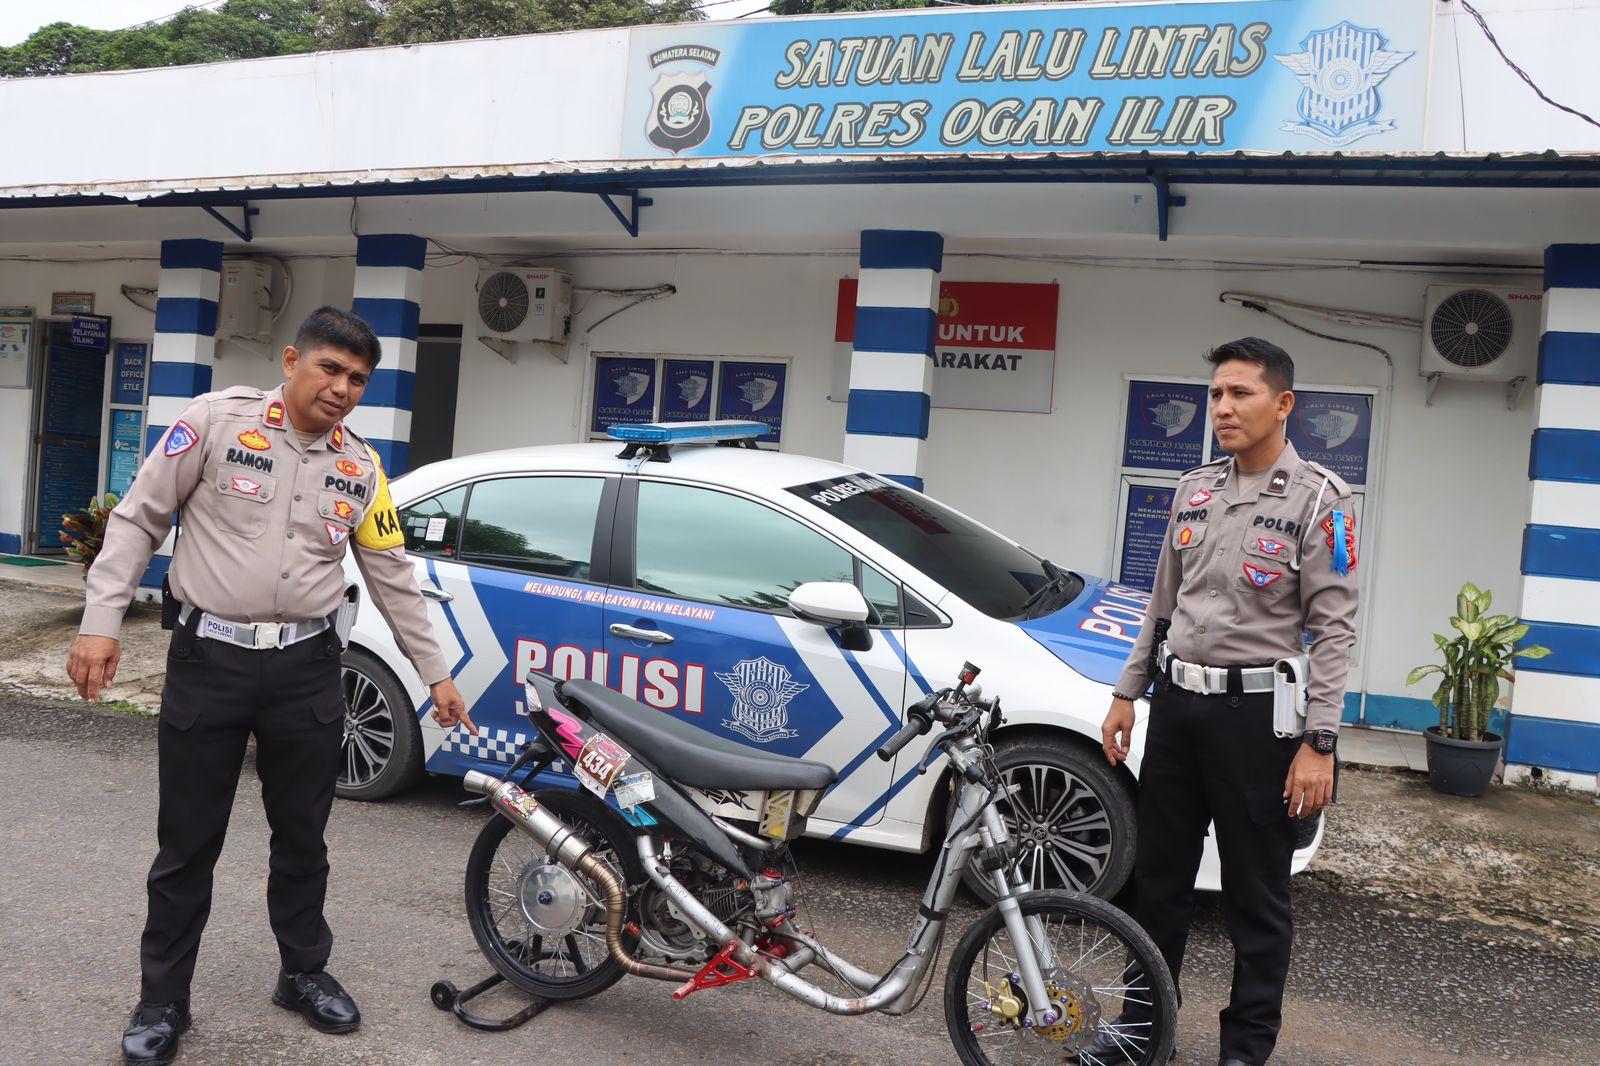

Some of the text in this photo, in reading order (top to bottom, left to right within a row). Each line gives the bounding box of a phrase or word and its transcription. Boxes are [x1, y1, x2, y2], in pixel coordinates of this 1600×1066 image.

[653, 48, 717, 64] SUMATERA SELATAN
[775, 22, 1272, 89] SATUAN LALU LINTAS
[727, 96, 1237, 150] POLRES OGAN ILIR
[1508, 293, 1543, 301] SHARP
[80, 321, 100, 330] RUANG
[938, 323, 1024, 343] UNTUK
[73, 336, 94, 345] TILANG
[123, 358, 142, 366] BACK
[120, 370, 145, 378] OFFICE
[123, 383, 140, 391] ETLE
[1167, 393, 1194, 401] LINTAS
[1327, 404, 1356, 412] LINTAS
[226, 447, 273, 473] RAMON
[325, 475, 367, 499] POLRI
[1176, 508, 1208, 523] BOWO
[1253, 514, 1300, 536] POLRI
[523, 581, 715, 621] MELINDUNGI, MENGAYOMI DAN MELAYANI
[207, 620, 233, 635] POLISI
[515, 638, 705, 714] POLISI
[582, 750, 614, 781] 434
